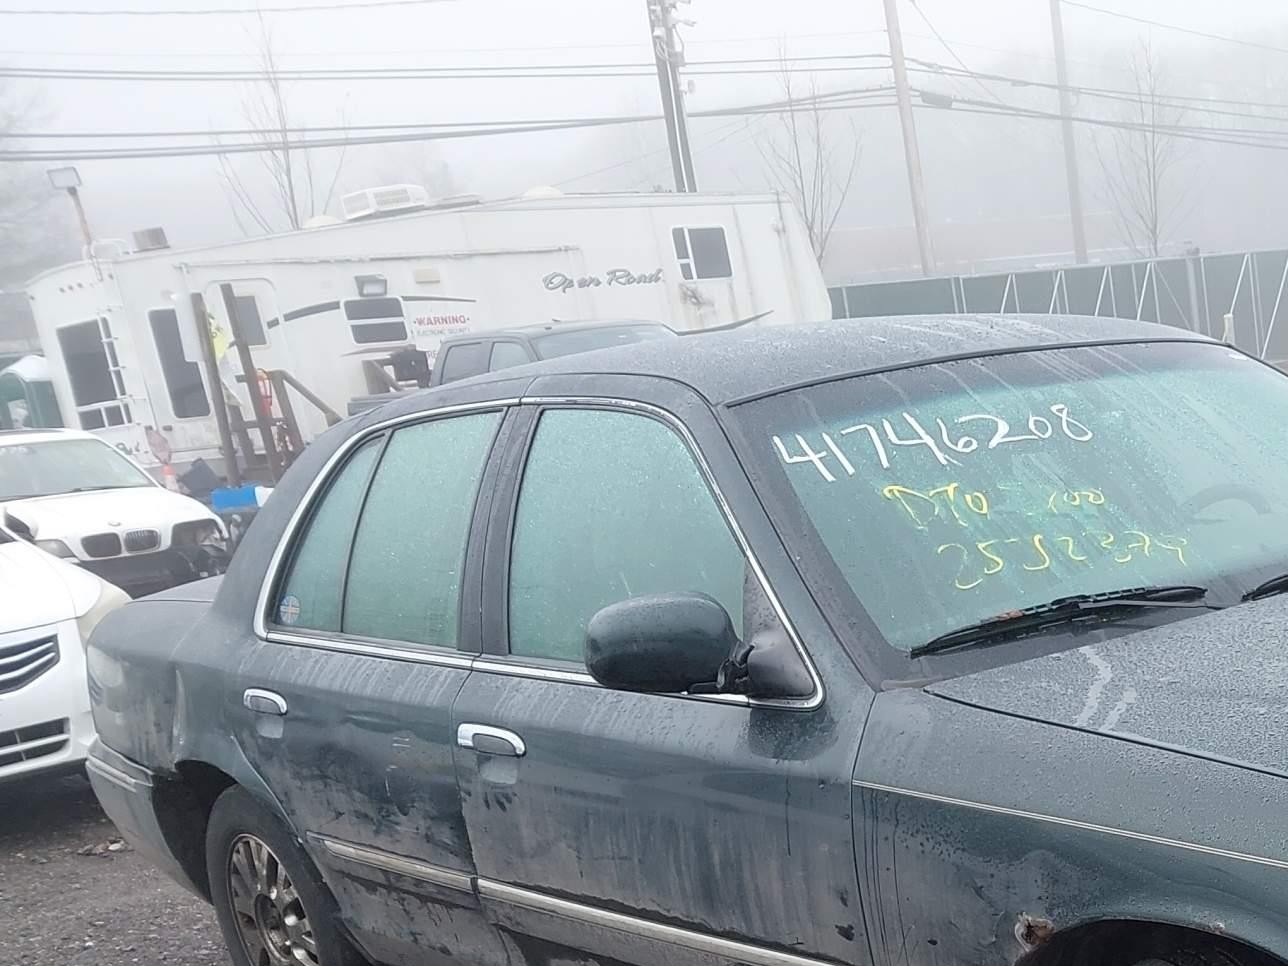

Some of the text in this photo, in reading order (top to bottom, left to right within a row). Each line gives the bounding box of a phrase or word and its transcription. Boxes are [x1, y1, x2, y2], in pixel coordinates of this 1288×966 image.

[542, 268, 662, 293] Open Road
[772, 404, 1094, 482] 41746208
